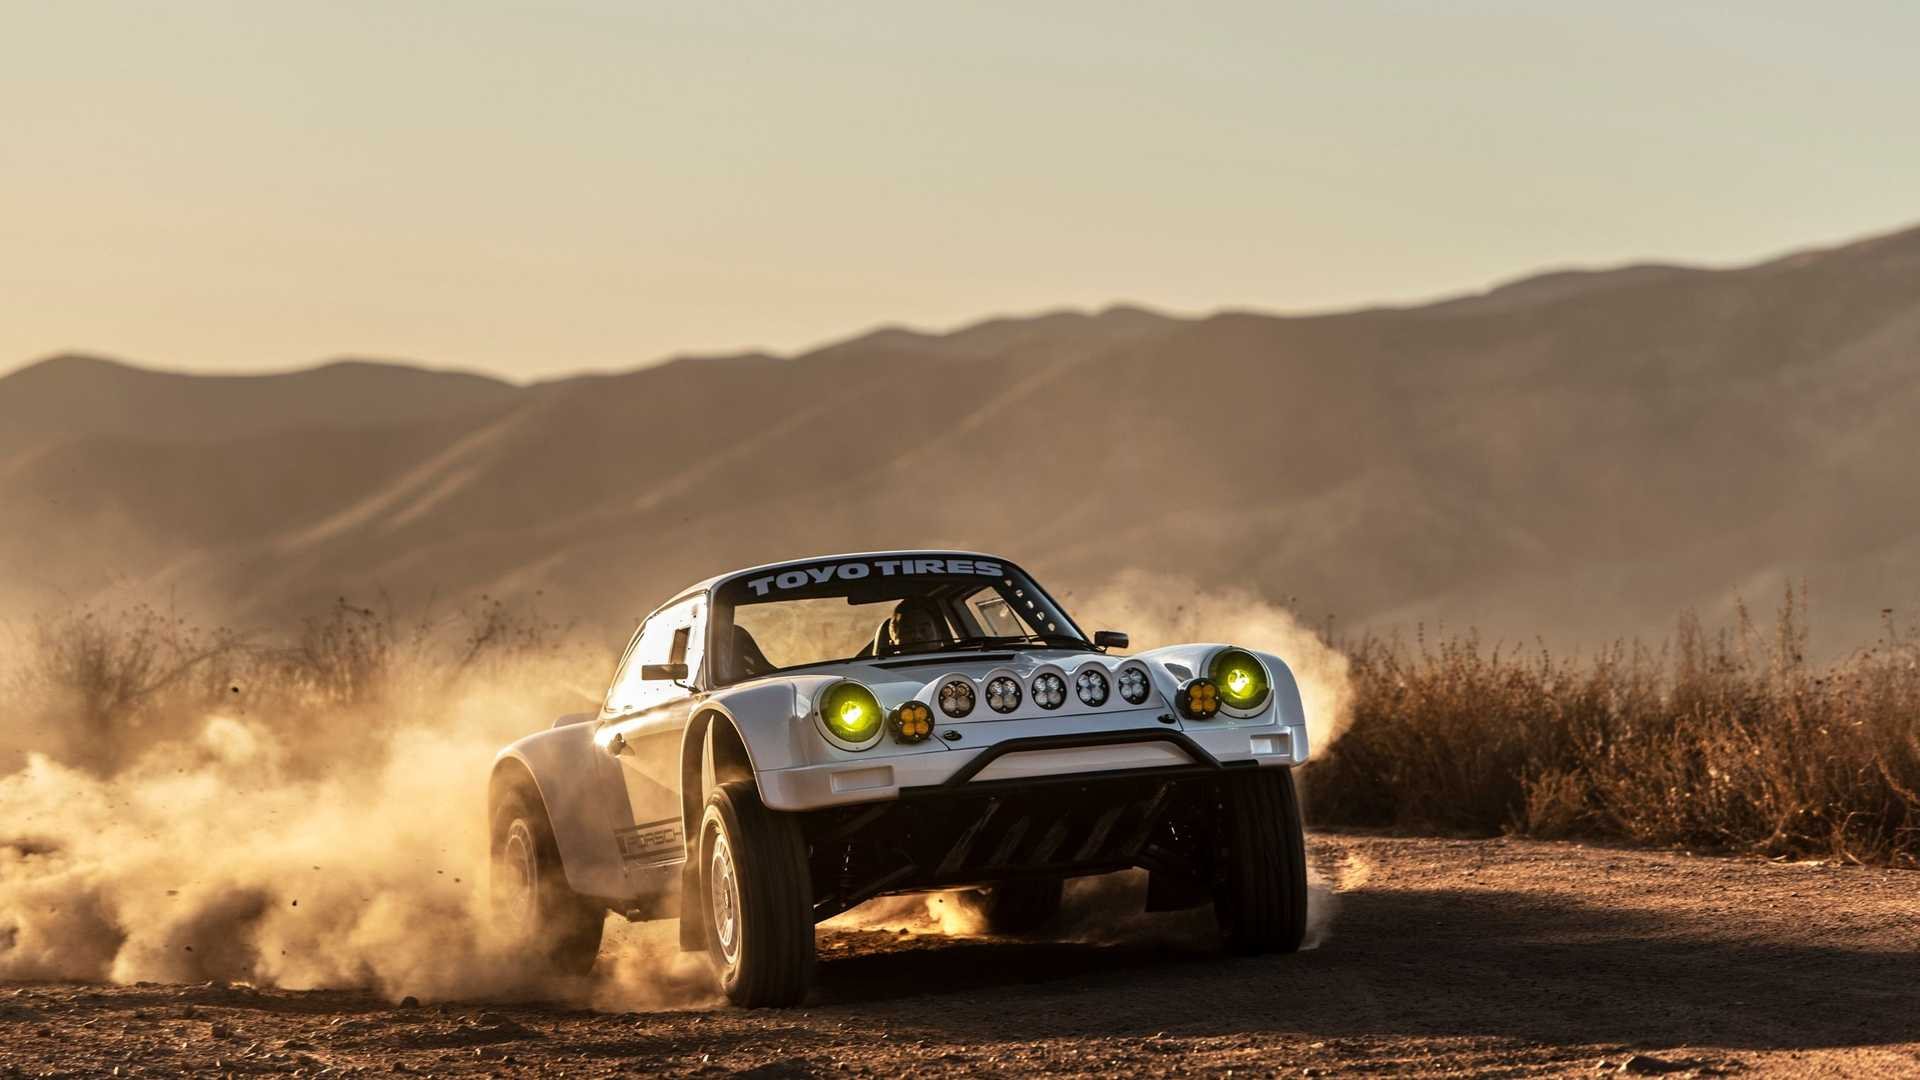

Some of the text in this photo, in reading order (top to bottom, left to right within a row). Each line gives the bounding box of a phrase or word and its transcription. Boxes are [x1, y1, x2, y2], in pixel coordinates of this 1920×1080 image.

[748, 560, 1004, 596] TOYO TIRES
[626, 825, 684, 850] PORSCH
